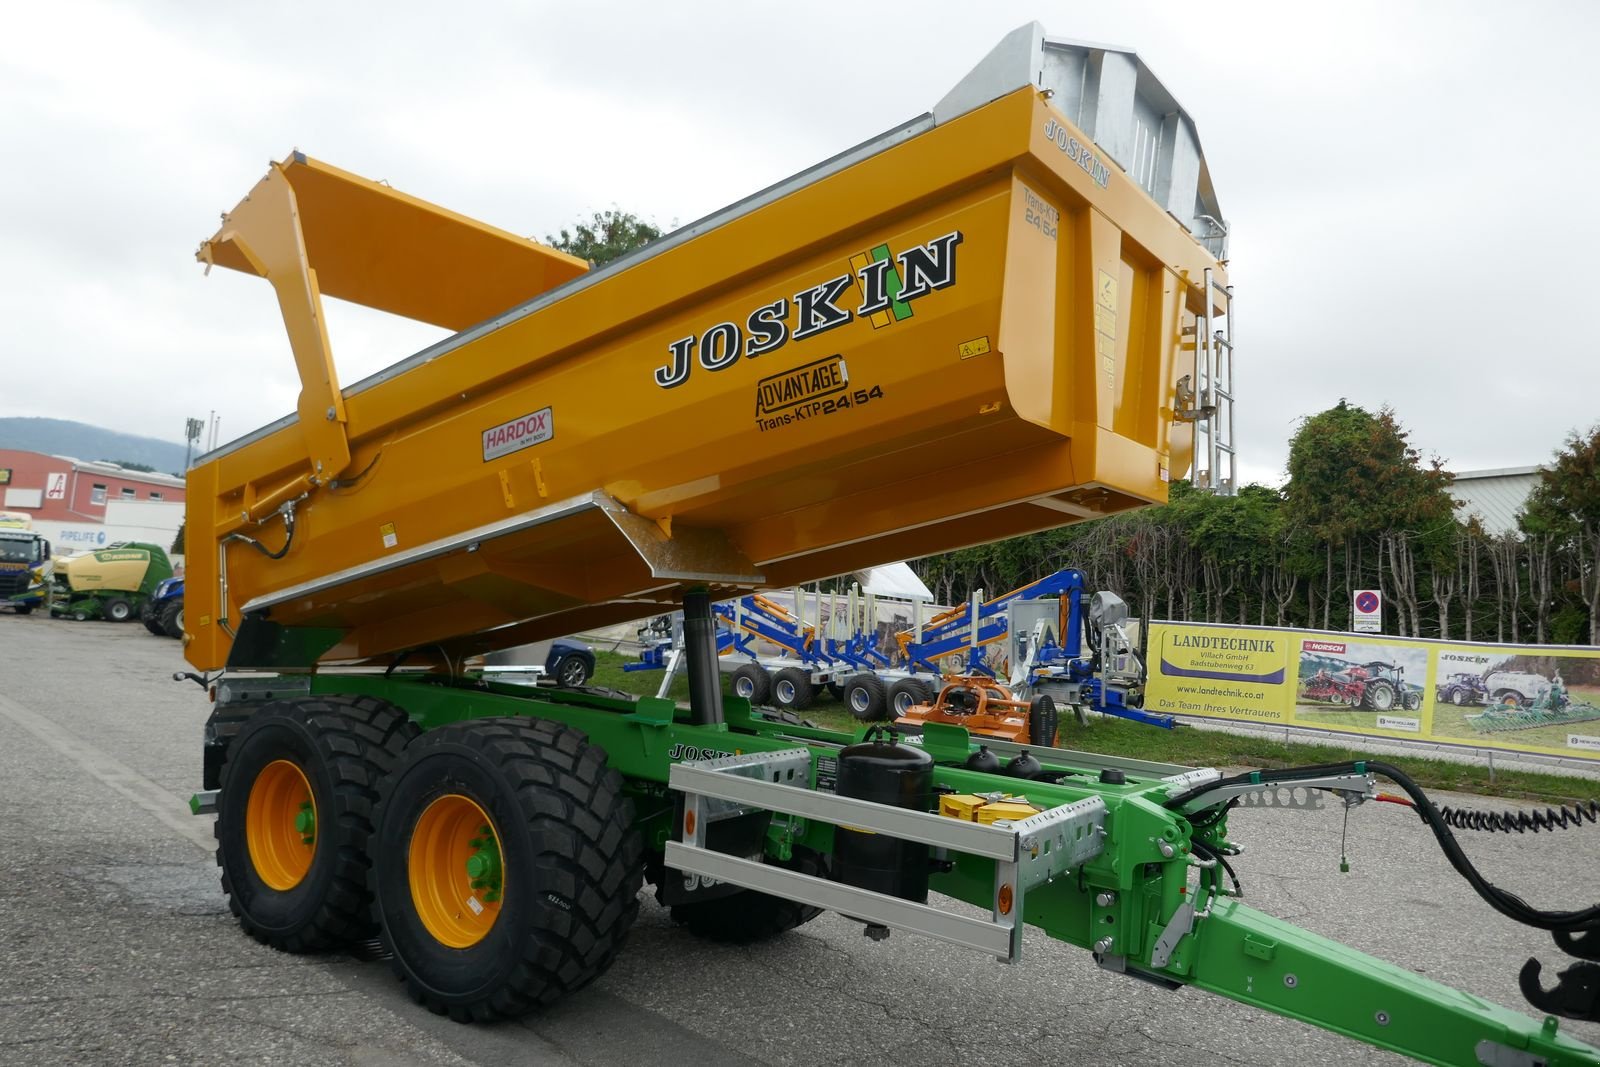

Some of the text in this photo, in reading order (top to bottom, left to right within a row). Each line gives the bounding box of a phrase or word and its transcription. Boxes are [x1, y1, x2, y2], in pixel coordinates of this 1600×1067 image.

[1044, 117, 1110, 189] JOSKIN
[1023, 187, 1059, 224] Trans-KTP
[655, 230, 963, 389] JOSKIN
[755, 362, 841, 417] ADVANTAGE
[487, 413, 546, 449] HARDOX
[534, 433, 546, 441] BODY
[60, 530, 95, 543] PIPELIFE
[1173, 634, 1275, 653] LANDTECHNIK
[1311, 643, 1344, 652] HORSCH
[1200, 652, 1249, 661] Villach GmbH
[1441, 653, 1489, 664] JOSKIN
[1190, 660, 1243, 671] Badstubenweg
[1177, 685, 1264, 700] www.landtechnik.co.at
[1159, 699, 1281, 719] Das Team Ihres Vertrauens
